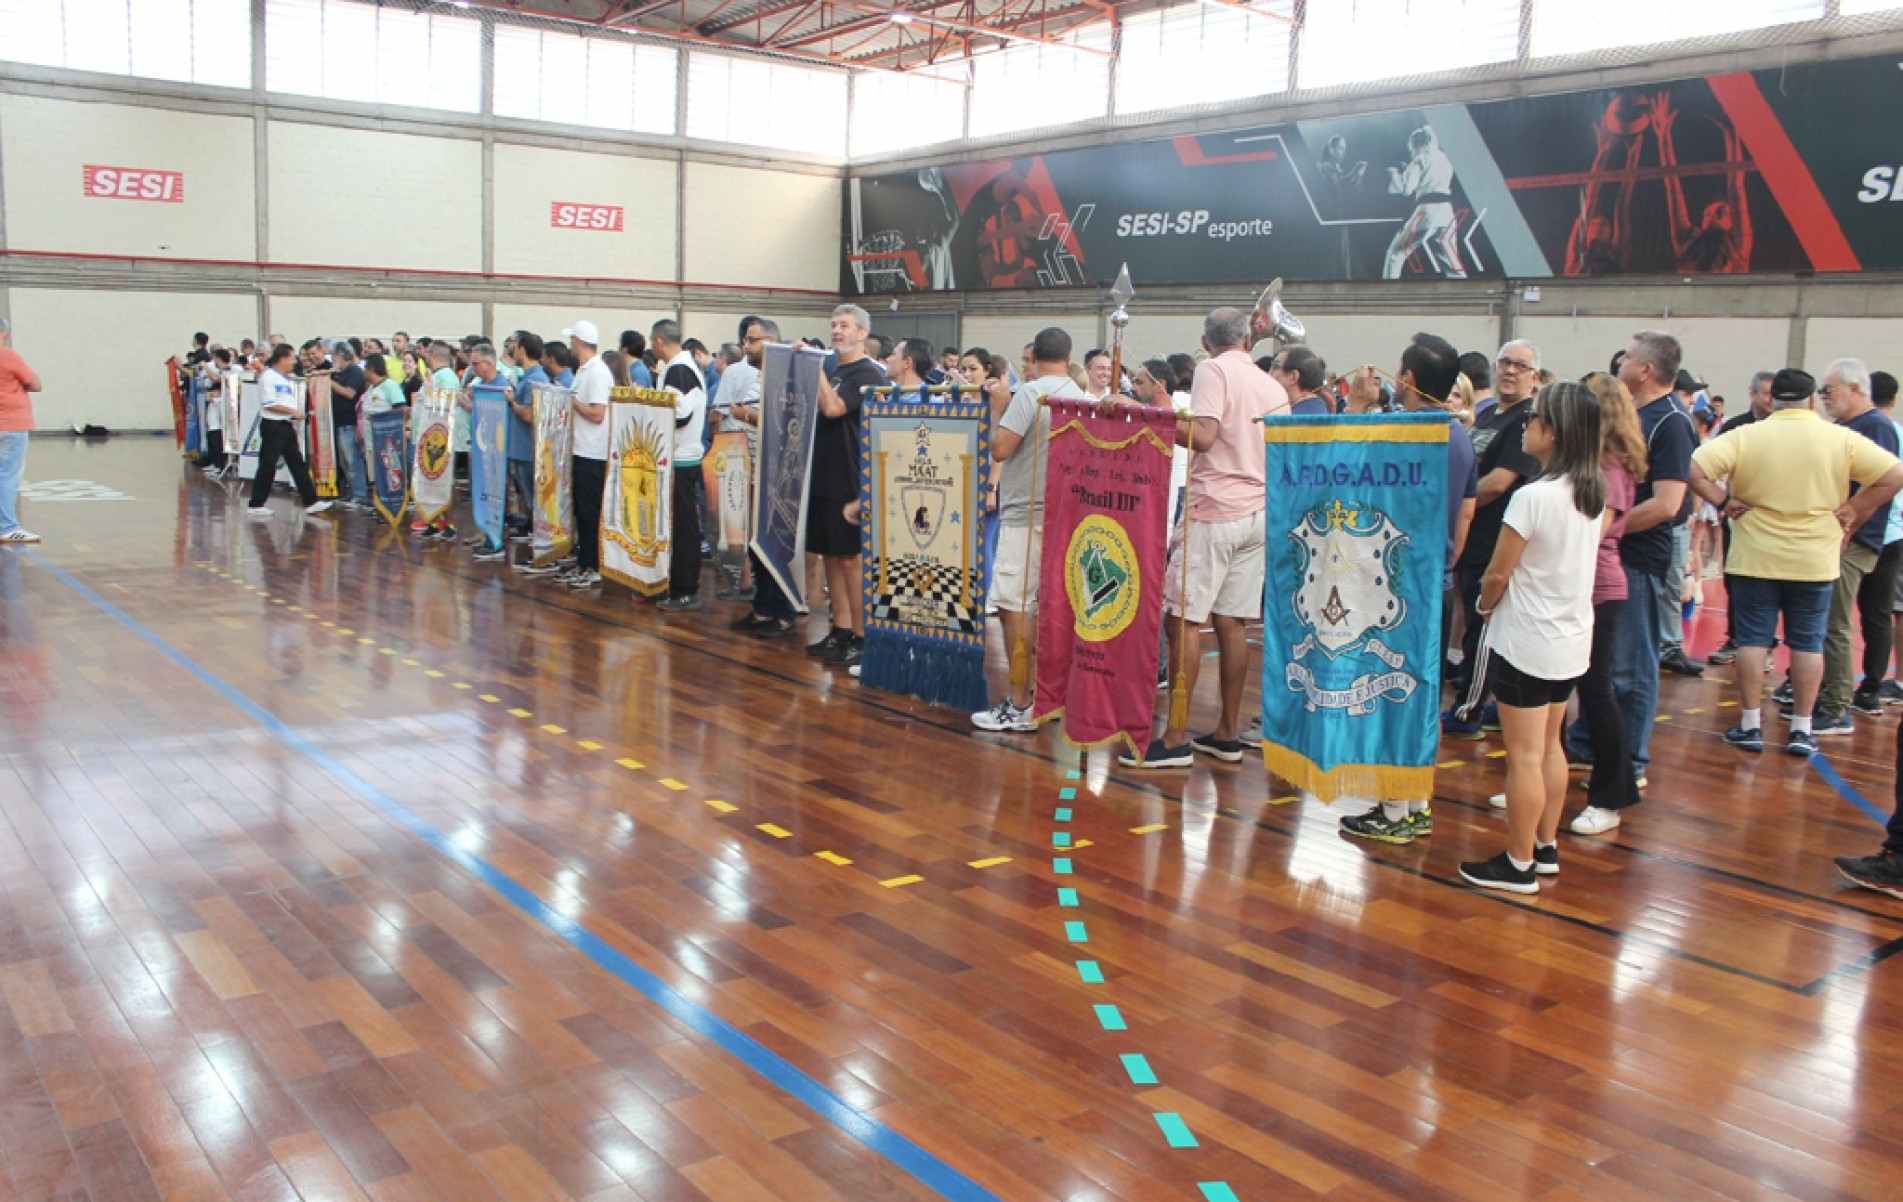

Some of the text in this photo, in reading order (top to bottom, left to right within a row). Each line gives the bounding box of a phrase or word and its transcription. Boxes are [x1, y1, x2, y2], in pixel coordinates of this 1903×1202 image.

[92, 169, 174, 200] SESI
[557, 206, 617, 229] SESI
[1116, 210, 1273, 242] SESI-SP esporte
